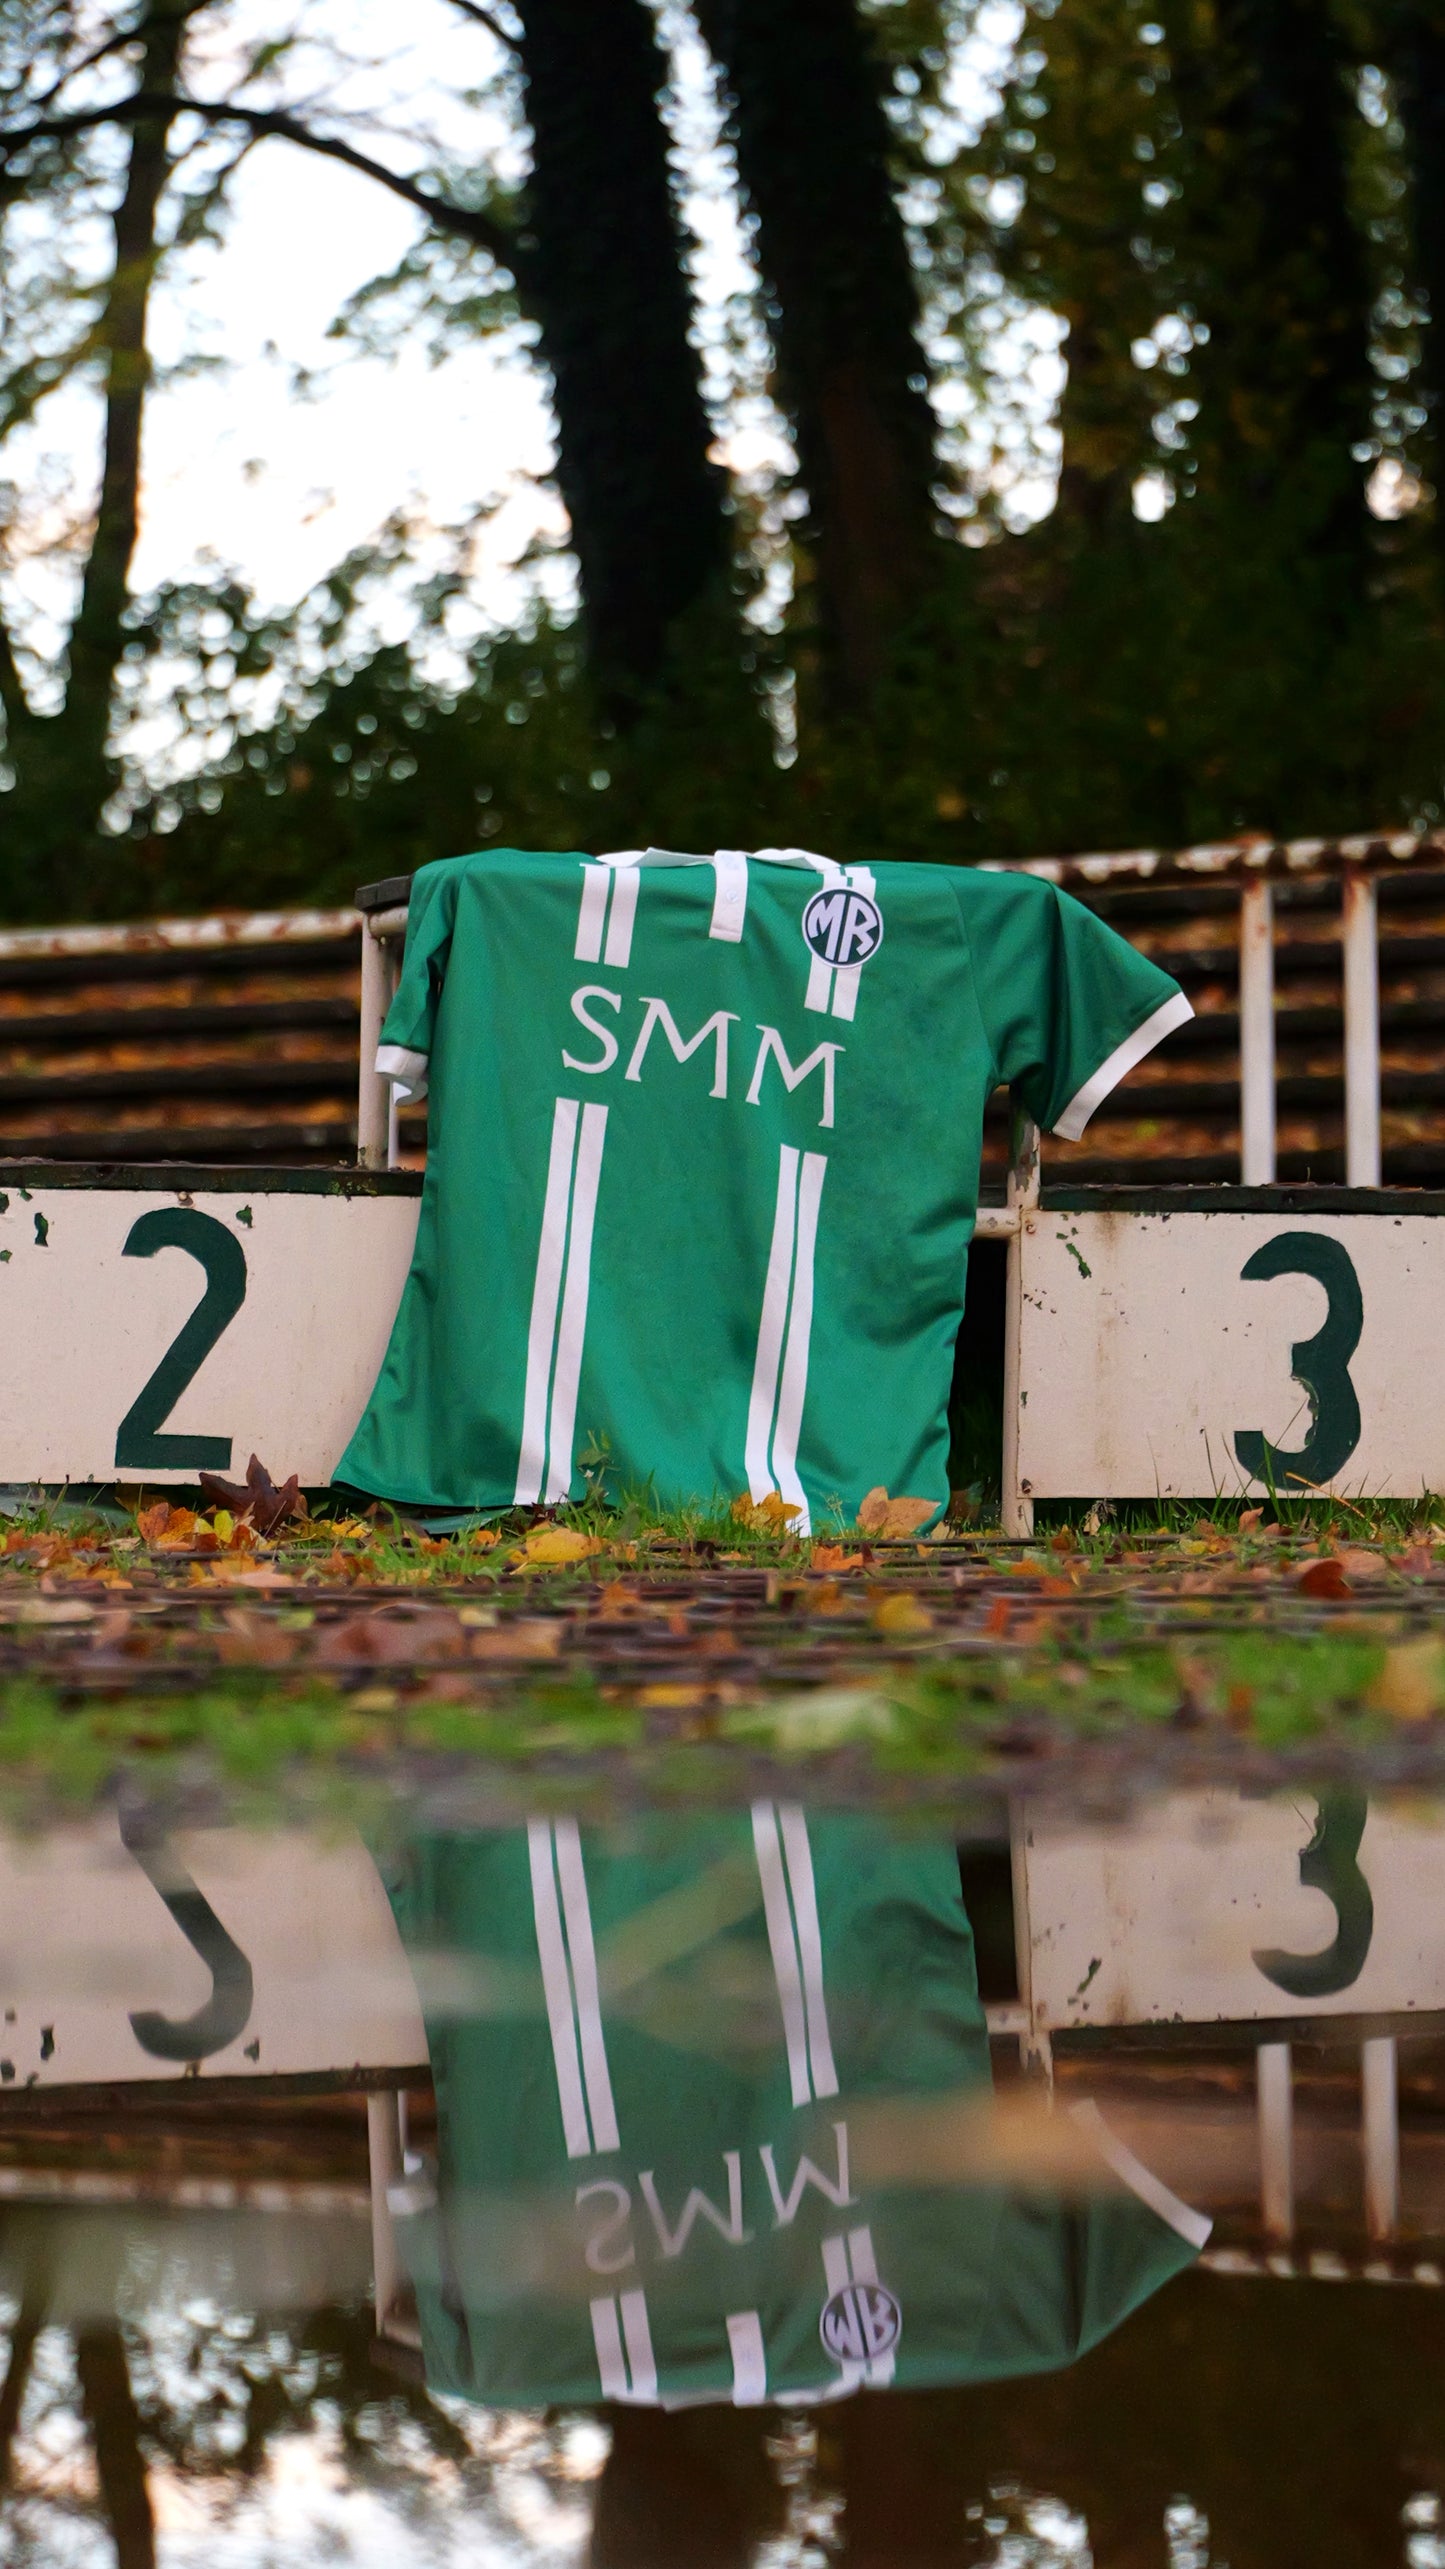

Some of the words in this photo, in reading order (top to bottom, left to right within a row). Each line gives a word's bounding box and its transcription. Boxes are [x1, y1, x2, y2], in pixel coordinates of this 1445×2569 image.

[561, 984, 847, 1129] SMM
[114, 1206, 248, 1471] 2
[1233, 1230, 1364, 1491] 3
